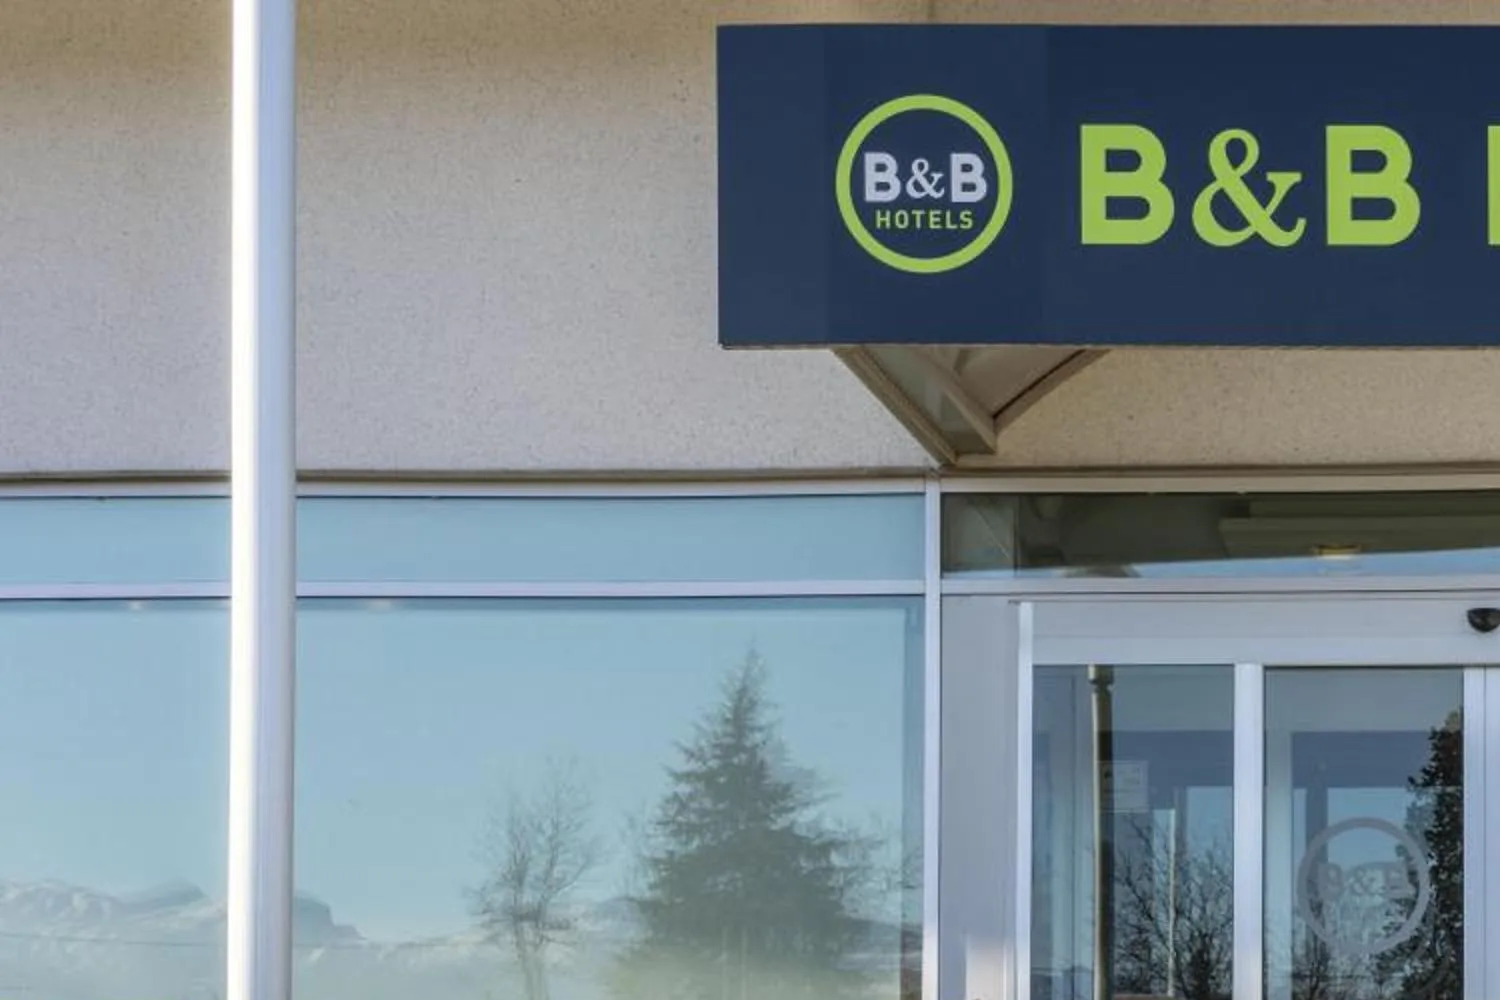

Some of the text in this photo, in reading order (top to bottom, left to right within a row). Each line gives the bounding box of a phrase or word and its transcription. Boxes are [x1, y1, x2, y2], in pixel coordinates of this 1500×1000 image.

[863, 153, 988, 203] B&B
[1080, 123, 1421, 247] B&B
[876, 209, 974, 230] HOTELS
